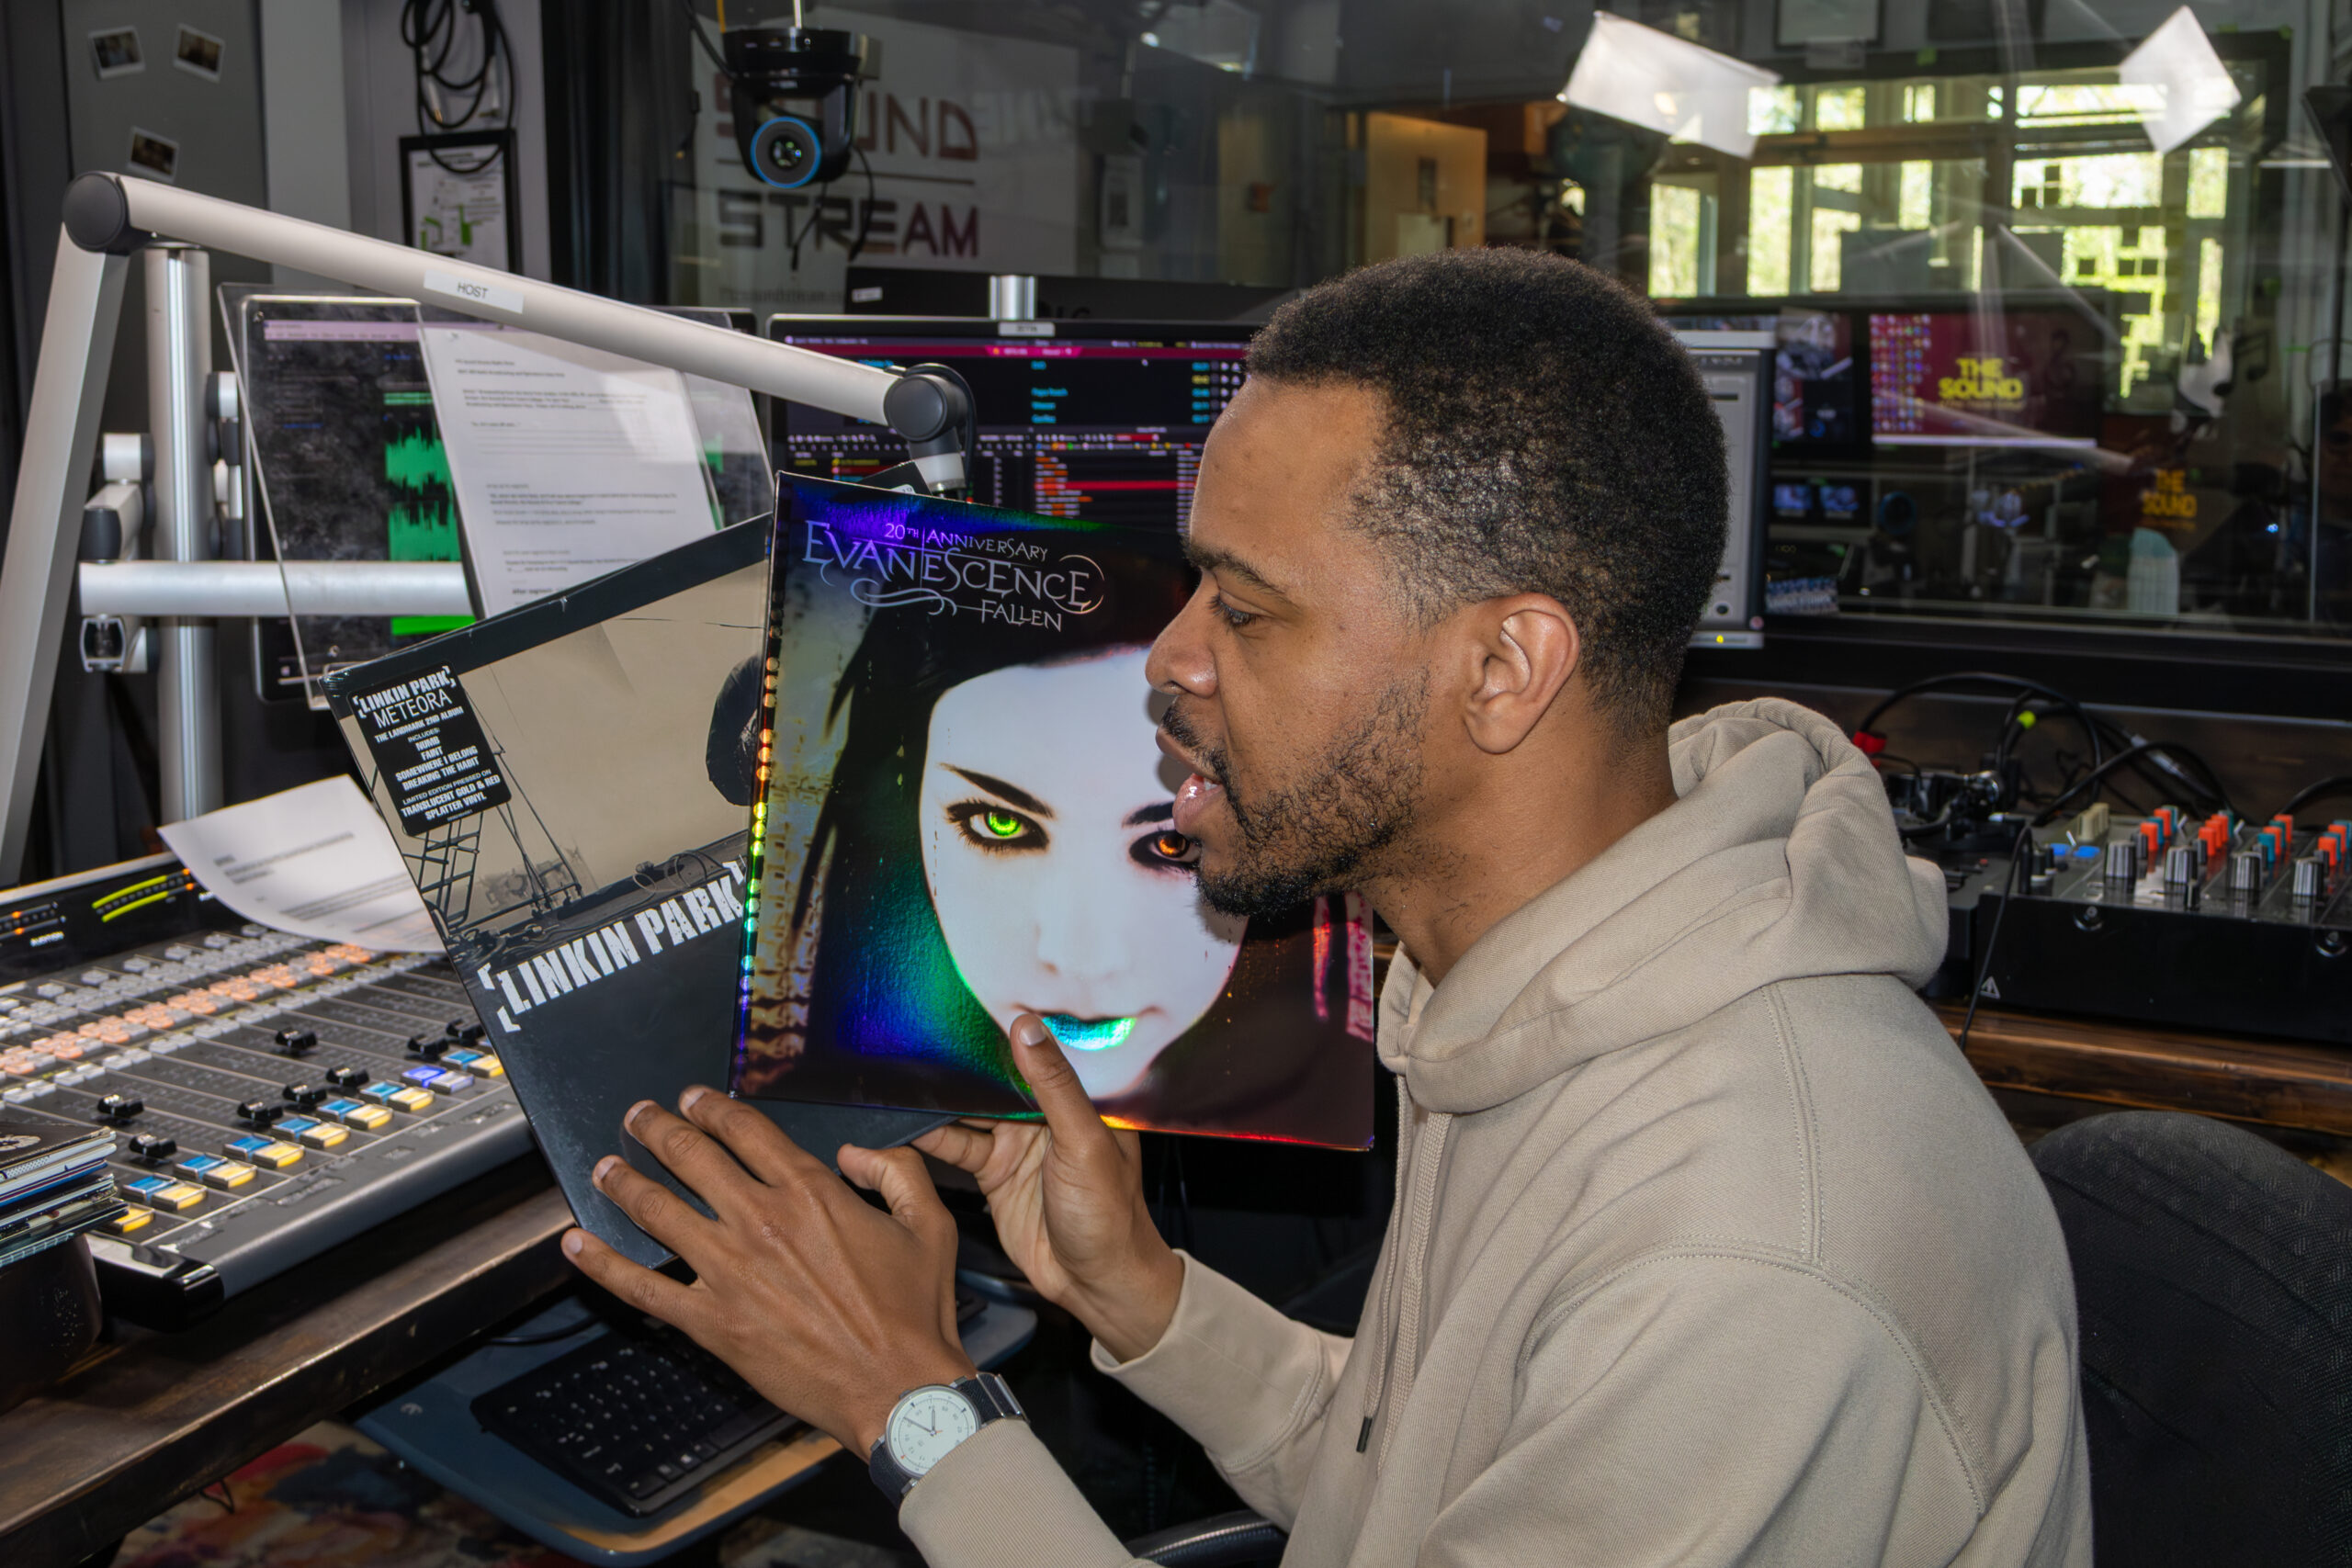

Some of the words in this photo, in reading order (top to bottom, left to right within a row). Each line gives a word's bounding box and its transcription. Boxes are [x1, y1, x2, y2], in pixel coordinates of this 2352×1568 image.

[719, 189, 978, 257] STREAM
[457, 282, 489, 299] HOST
[1955, 357, 2004, 378] THE
[1938, 377, 2024, 400] SOUND
[884, 523, 920, 540] 20TH
[925, 529, 1048, 562] ANNIVERSARY
[802, 520, 1091, 608] EVANESCENCE
[980, 599, 1062, 632] FALLEN
[358, 683, 411, 714] LINKIN
[409, 670, 450, 695] PARK
[373, 688, 452, 728] METEORA
[374, 732, 390, 744] THE
[390, 721, 425, 739] LANDMARK
[425, 715, 440, 727] 2ND
[440, 705, 464, 721] ALBUM
[415, 736, 441, 751] NUMB
[421, 746, 443, 761] FAINT
[395, 756, 444, 781] SOMEWHERE
[443, 756, 449, 765] I
[449, 746, 479, 761] BELONG
[401, 770, 442, 792] BREAKING
[441, 765, 457, 778] THE
[457, 756, 480, 772] HABIT
[401, 789, 456, 818] TRANSLUCENT
[455, 783, 477, 797] GOLD
[476, 780, 485, 790] &
[485, 774, 501, 787] RED
[402, 792, 428, 806] LIMITED
[427, 784, 453, 797] EDITION
[453, 773, 481, 788] PRESSED
[481, 769, 492, 779] ON
[425, 800, 463, 820] SPLATTER
[462, 792, 487, 807] VINYL
[496, 920, 641, 1015] LINKIN
[634, 874, 744, 955] PARK
